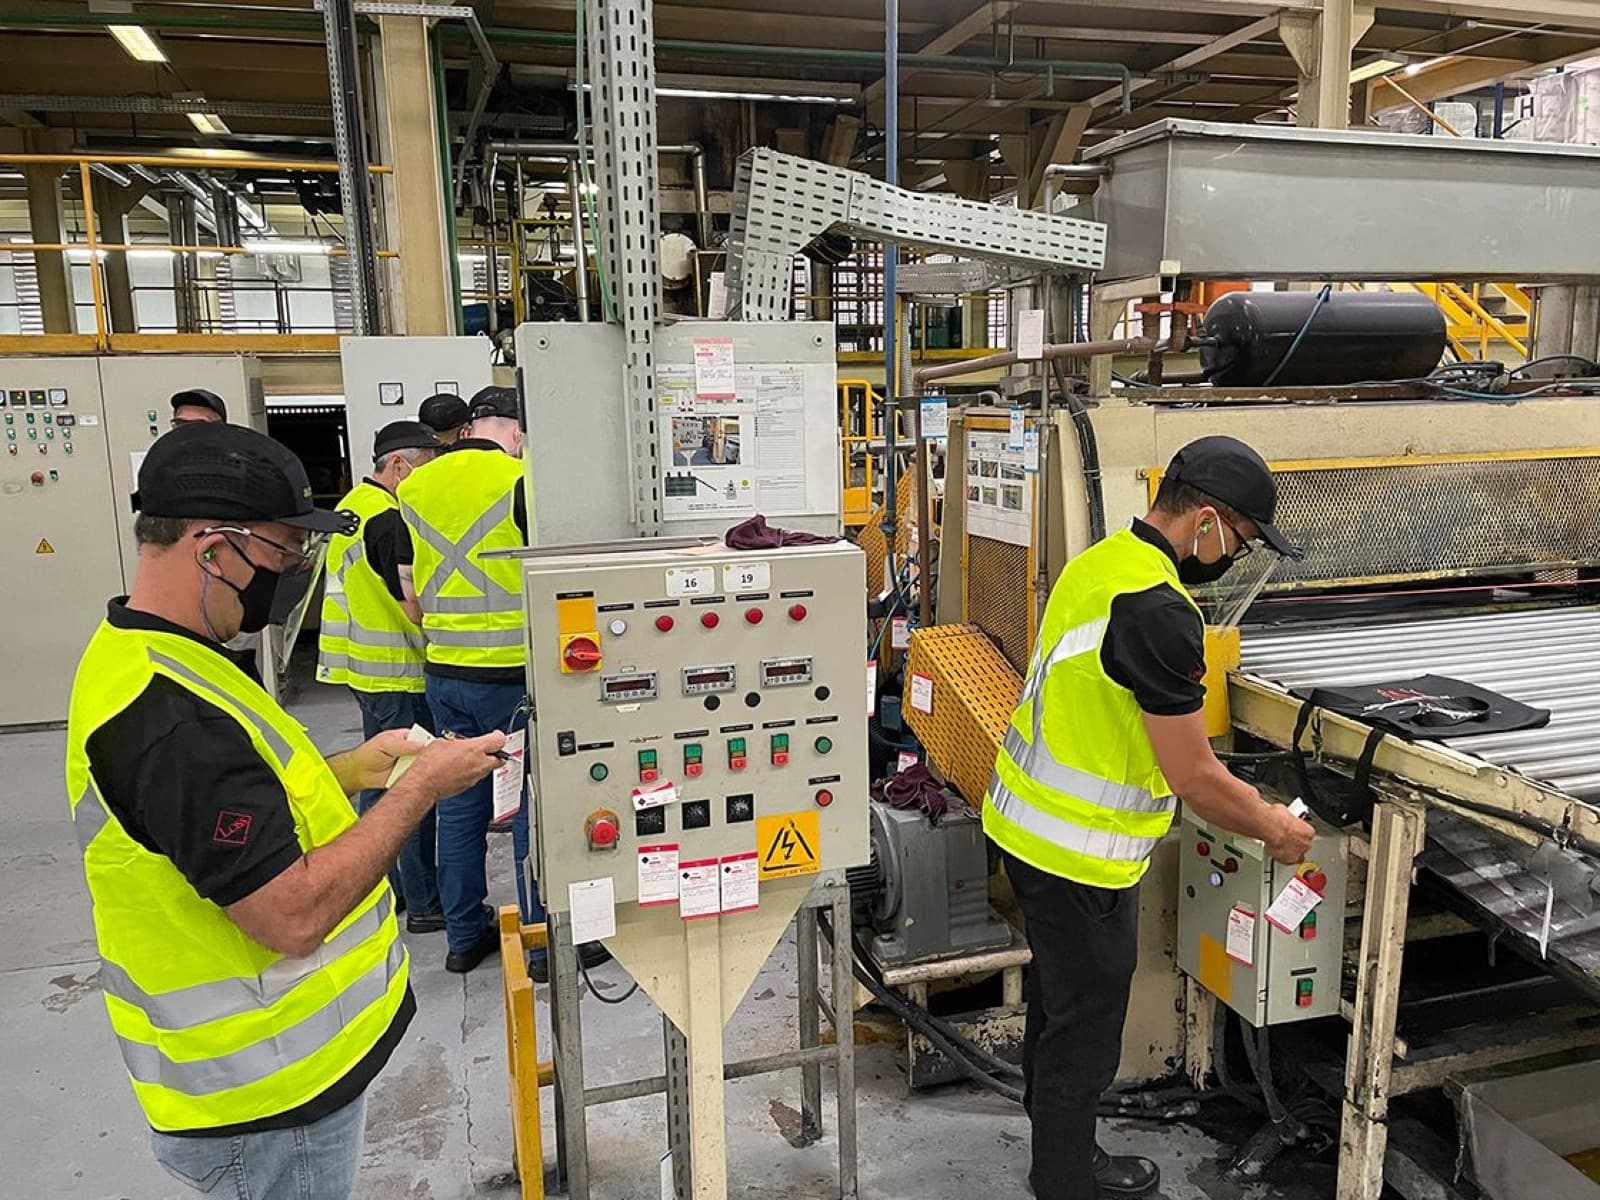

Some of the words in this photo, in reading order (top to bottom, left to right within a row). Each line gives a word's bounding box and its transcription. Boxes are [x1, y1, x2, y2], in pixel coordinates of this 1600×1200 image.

[1521, 96, 1533, 118] H
[684, 578, 697, 588] 16
[741, 574, 753, 584] 19
